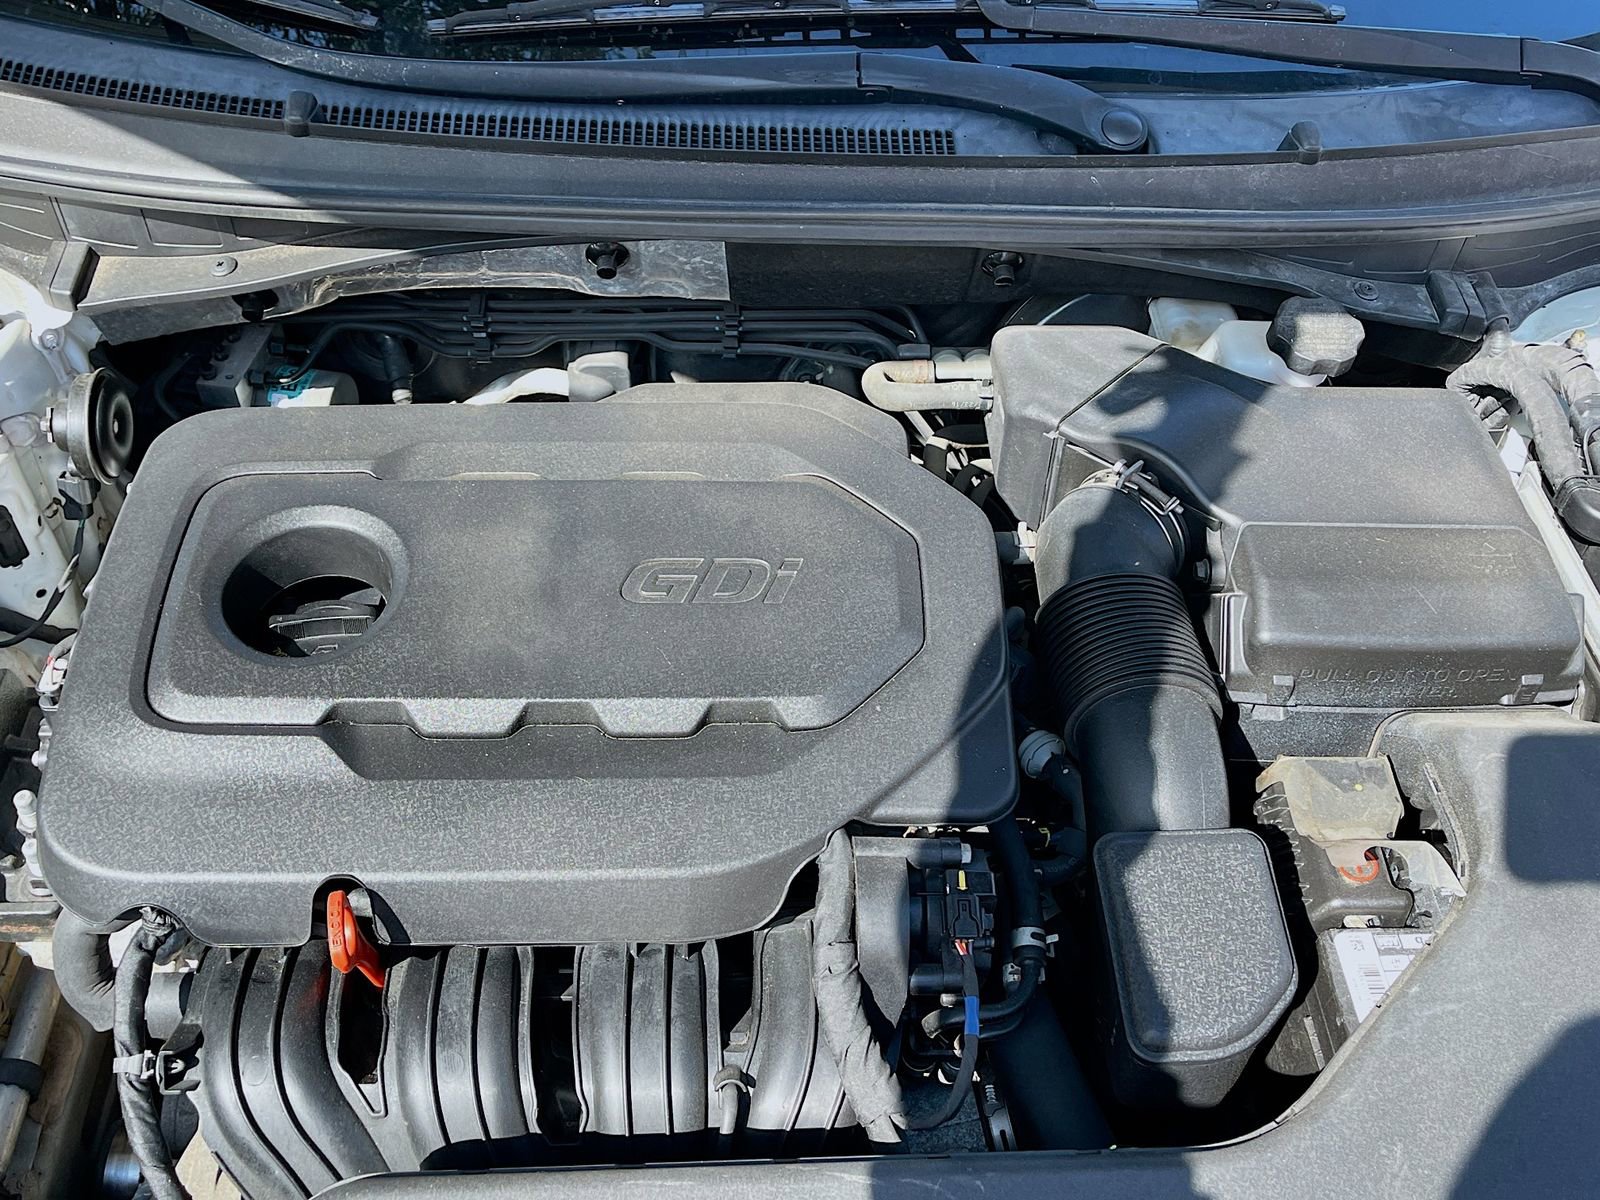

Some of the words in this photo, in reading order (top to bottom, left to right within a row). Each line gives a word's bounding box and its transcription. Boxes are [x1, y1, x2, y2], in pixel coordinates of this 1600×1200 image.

[619, 557, 804, 604] GDi
[1299, 668, 1357, 683] PULL
[1420, 669, 1451, 682] TO
[1456, 668, 1520, 682] OPEN
